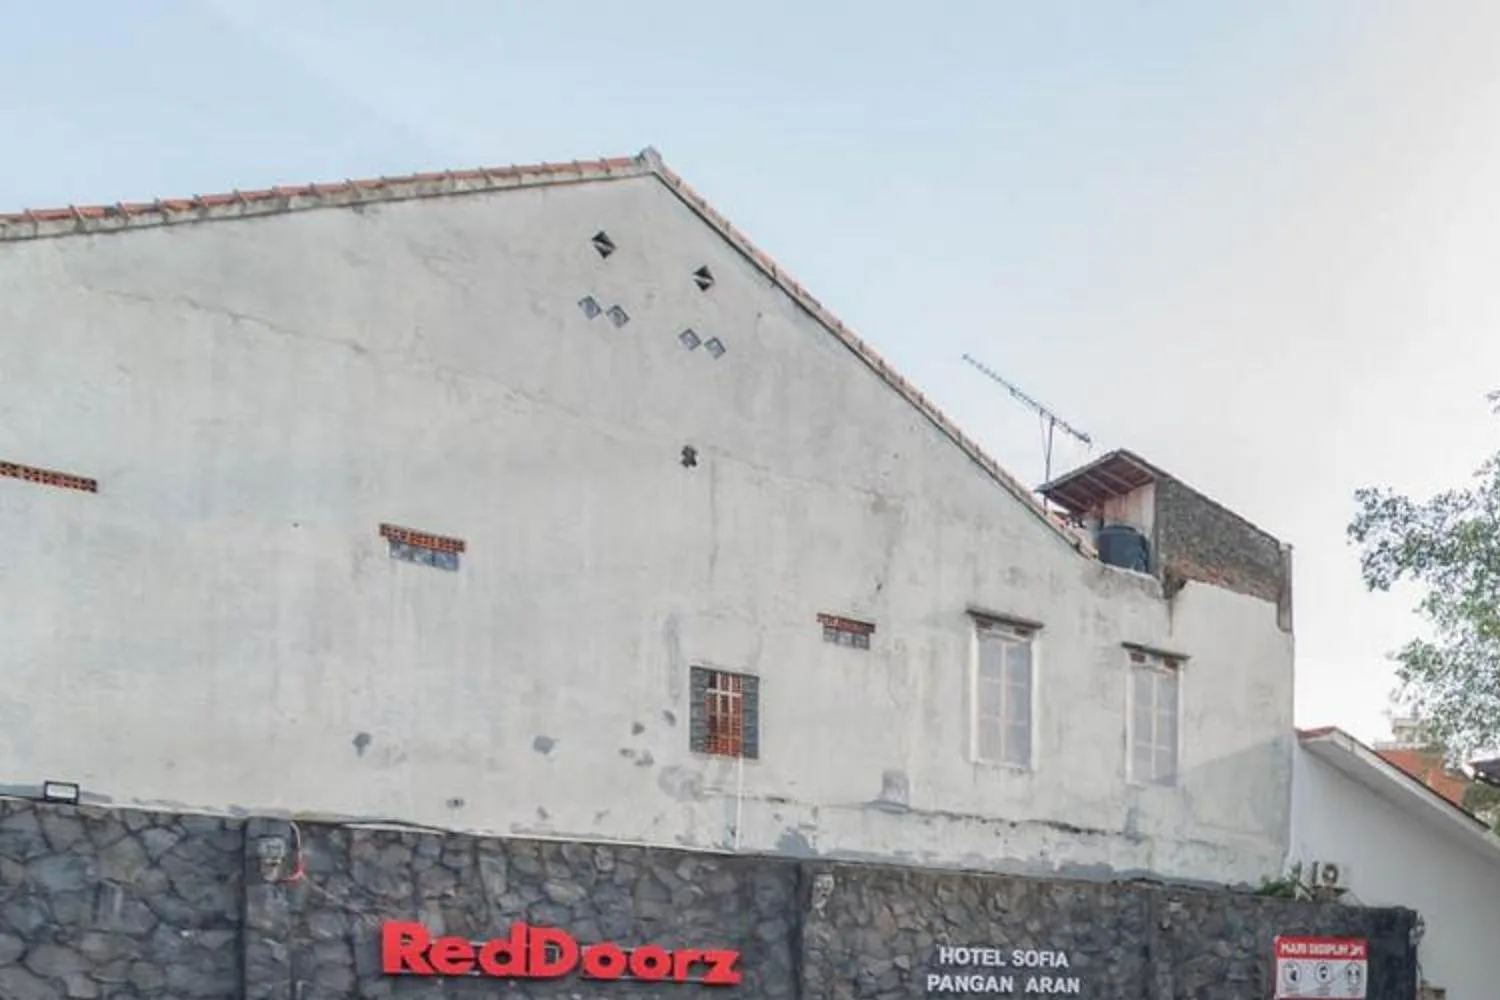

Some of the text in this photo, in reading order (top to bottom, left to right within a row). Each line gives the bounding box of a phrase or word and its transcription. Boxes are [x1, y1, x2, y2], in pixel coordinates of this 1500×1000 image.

[382, 920, 742, 985] RedDoorz
[939, 946, 1069, 968] HOTEL SOFIA
